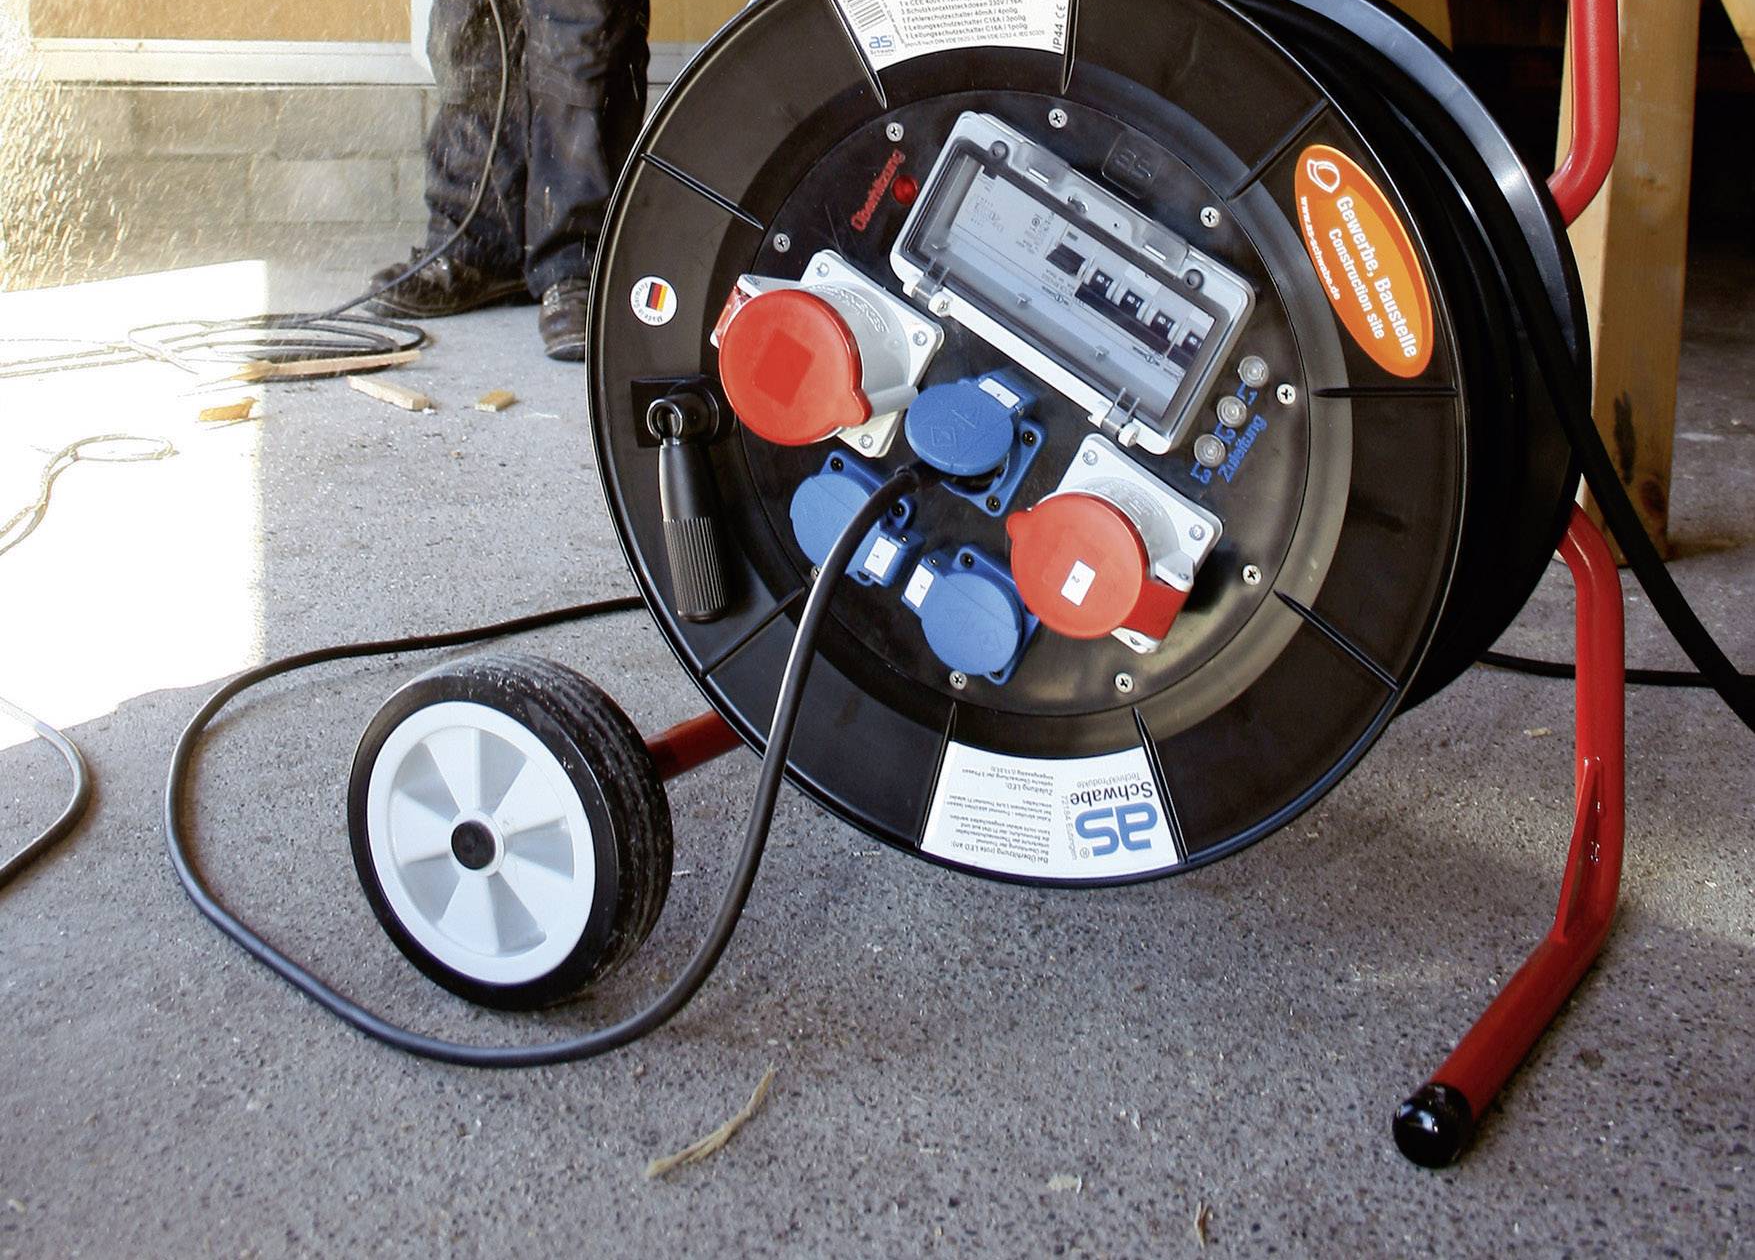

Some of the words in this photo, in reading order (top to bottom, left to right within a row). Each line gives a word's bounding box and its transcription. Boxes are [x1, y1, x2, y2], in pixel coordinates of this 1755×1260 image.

[1053, 23, 1064, 50] IP44
[1300, 195, 1341, 301] www.as-schwabe.de
[1328, 227, 1373, 312] Construction
[1366, 309, 1385, 340] site
[1335, 195, 1380, 278] Gewerbe,
[1374, 275, 1417, 359] Baustelle
[1070, 780, 1154, 806] Schwabe
[1074, 802, 1158, 857] as
